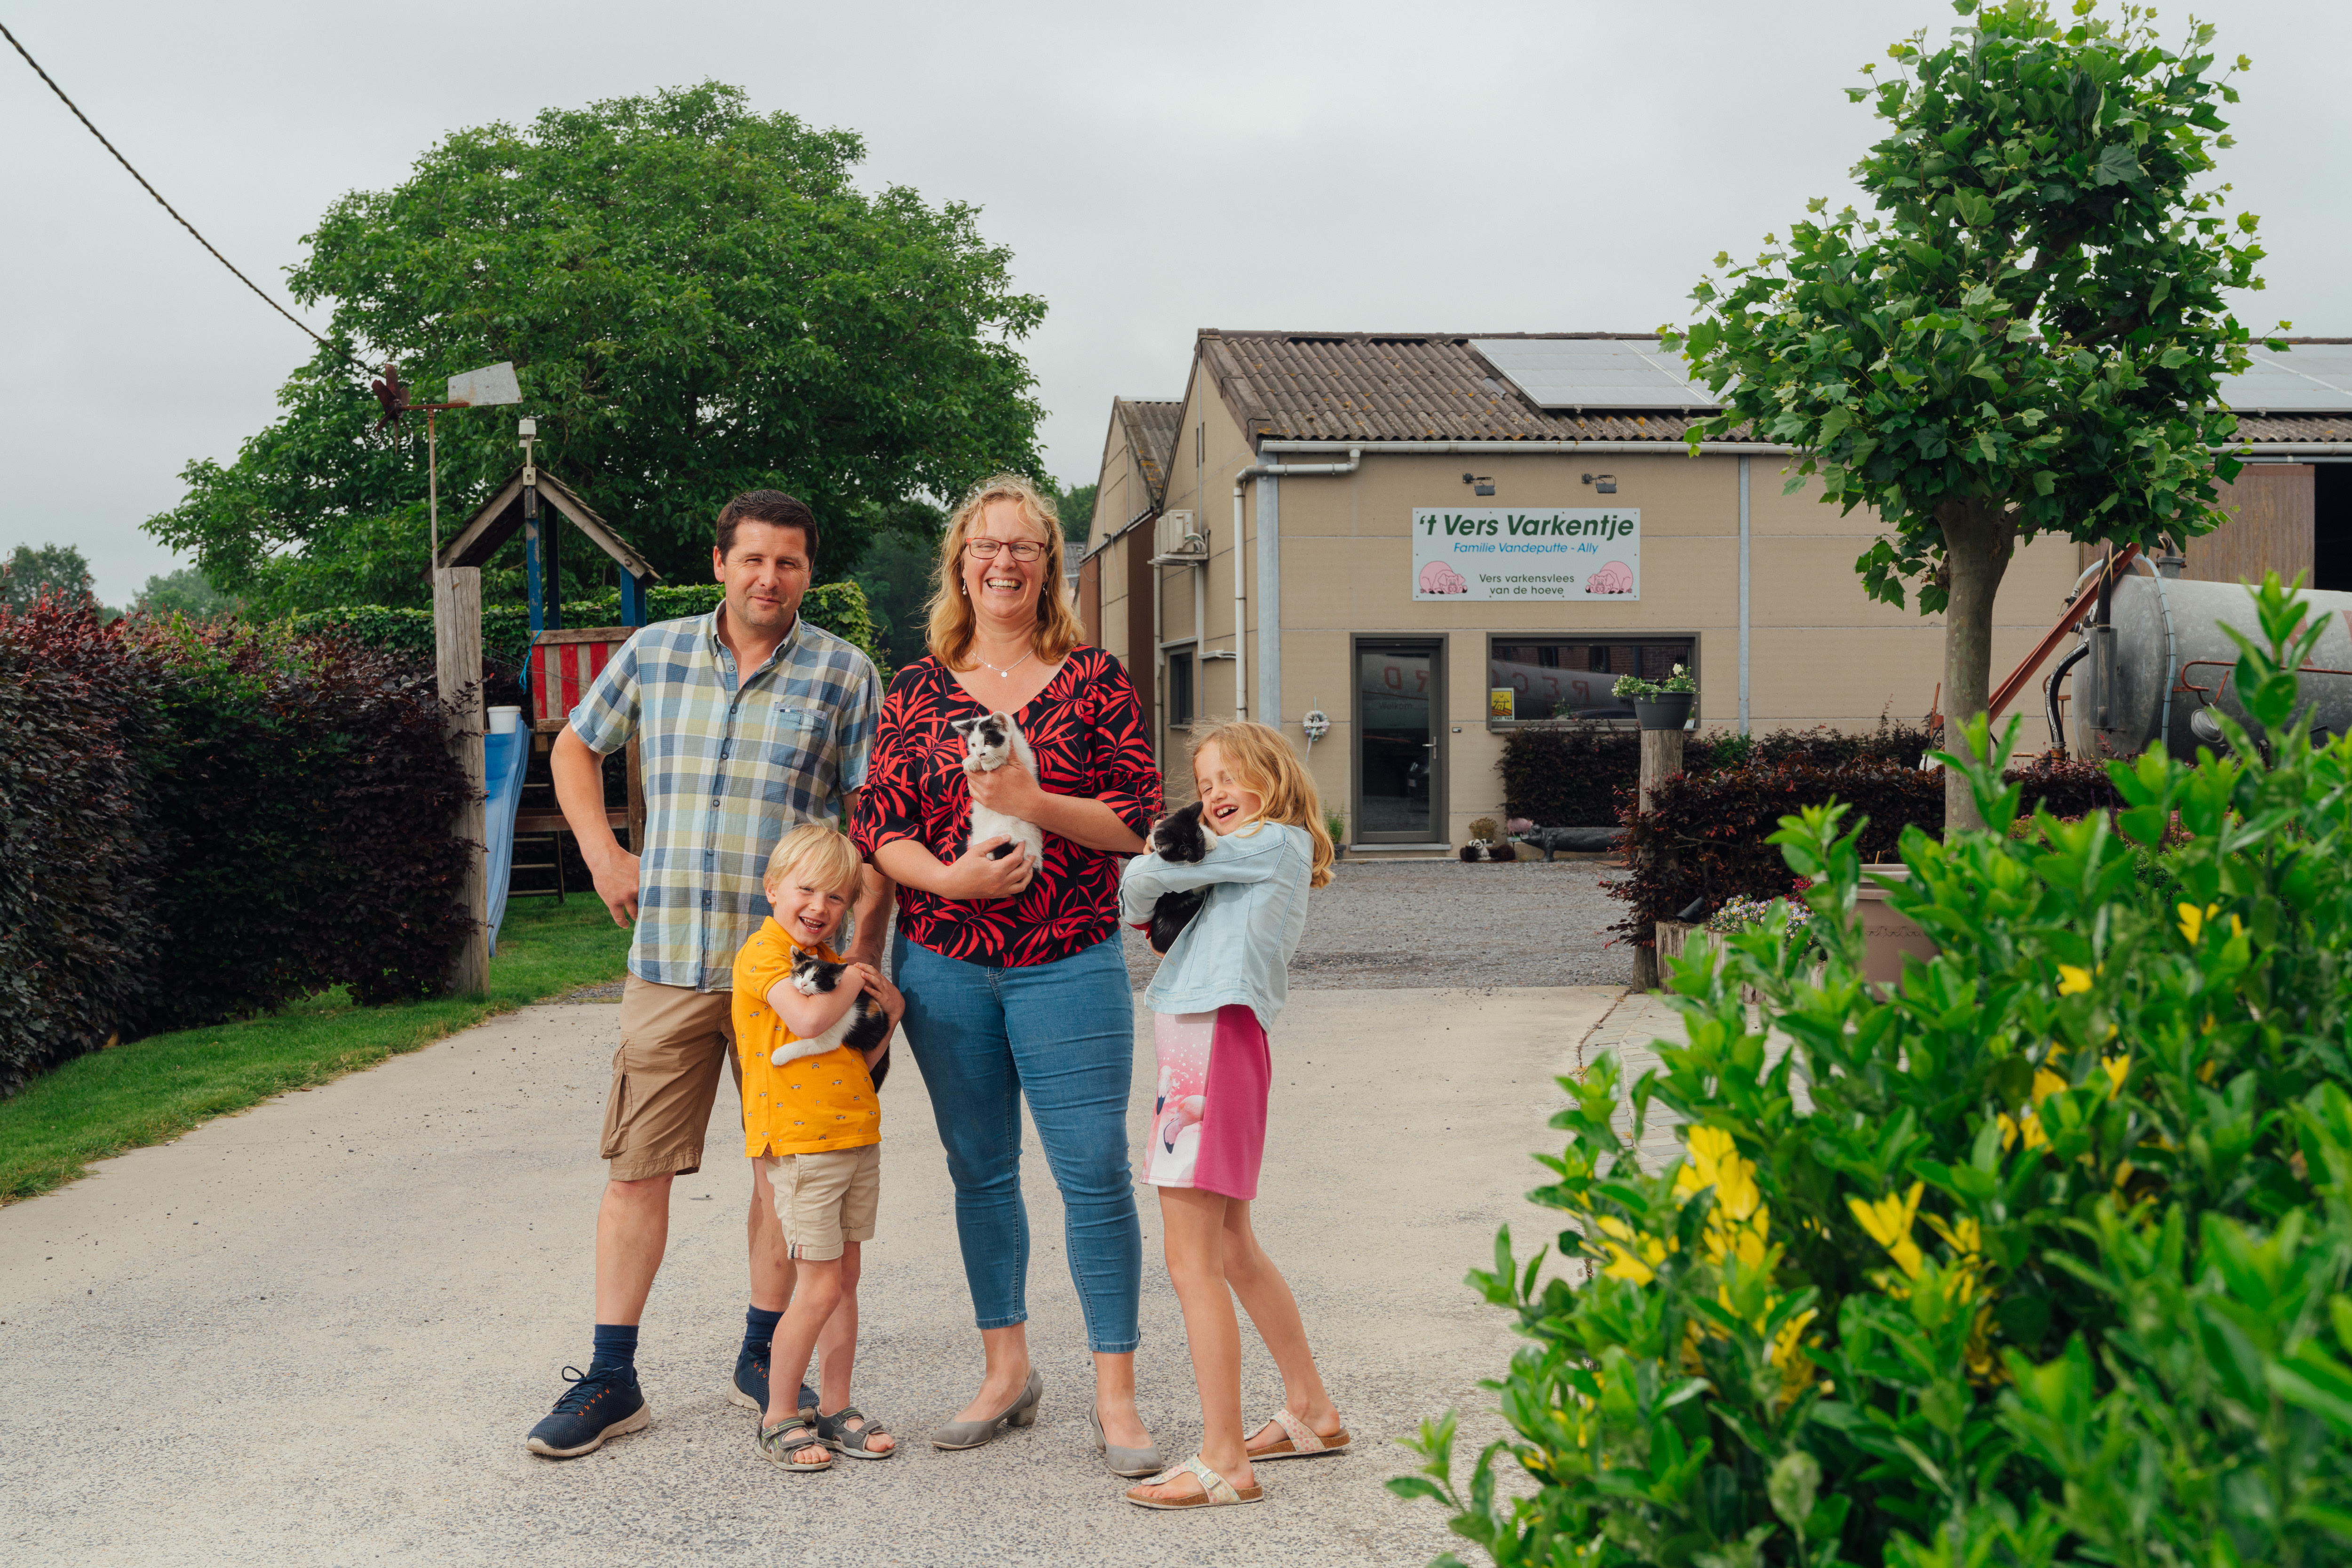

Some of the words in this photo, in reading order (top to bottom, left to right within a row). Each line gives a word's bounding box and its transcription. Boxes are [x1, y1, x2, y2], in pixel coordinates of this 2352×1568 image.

[1444, 515, 1498, 536] Vers
[1508, 515, 1634, 541] Varkentje
[1454, 542, 1495, 553] Familie
[1499, 542, 1567, 555] Vandeputte
[1577, 542, 1598, 555] Ally
[1479, 574, 1502, 583] Vers
[1505, 574, 1574, 583] varkensvlees
[1513, 585, 1527, 594] de
[1532, 585, 1564, 594] hoeve
